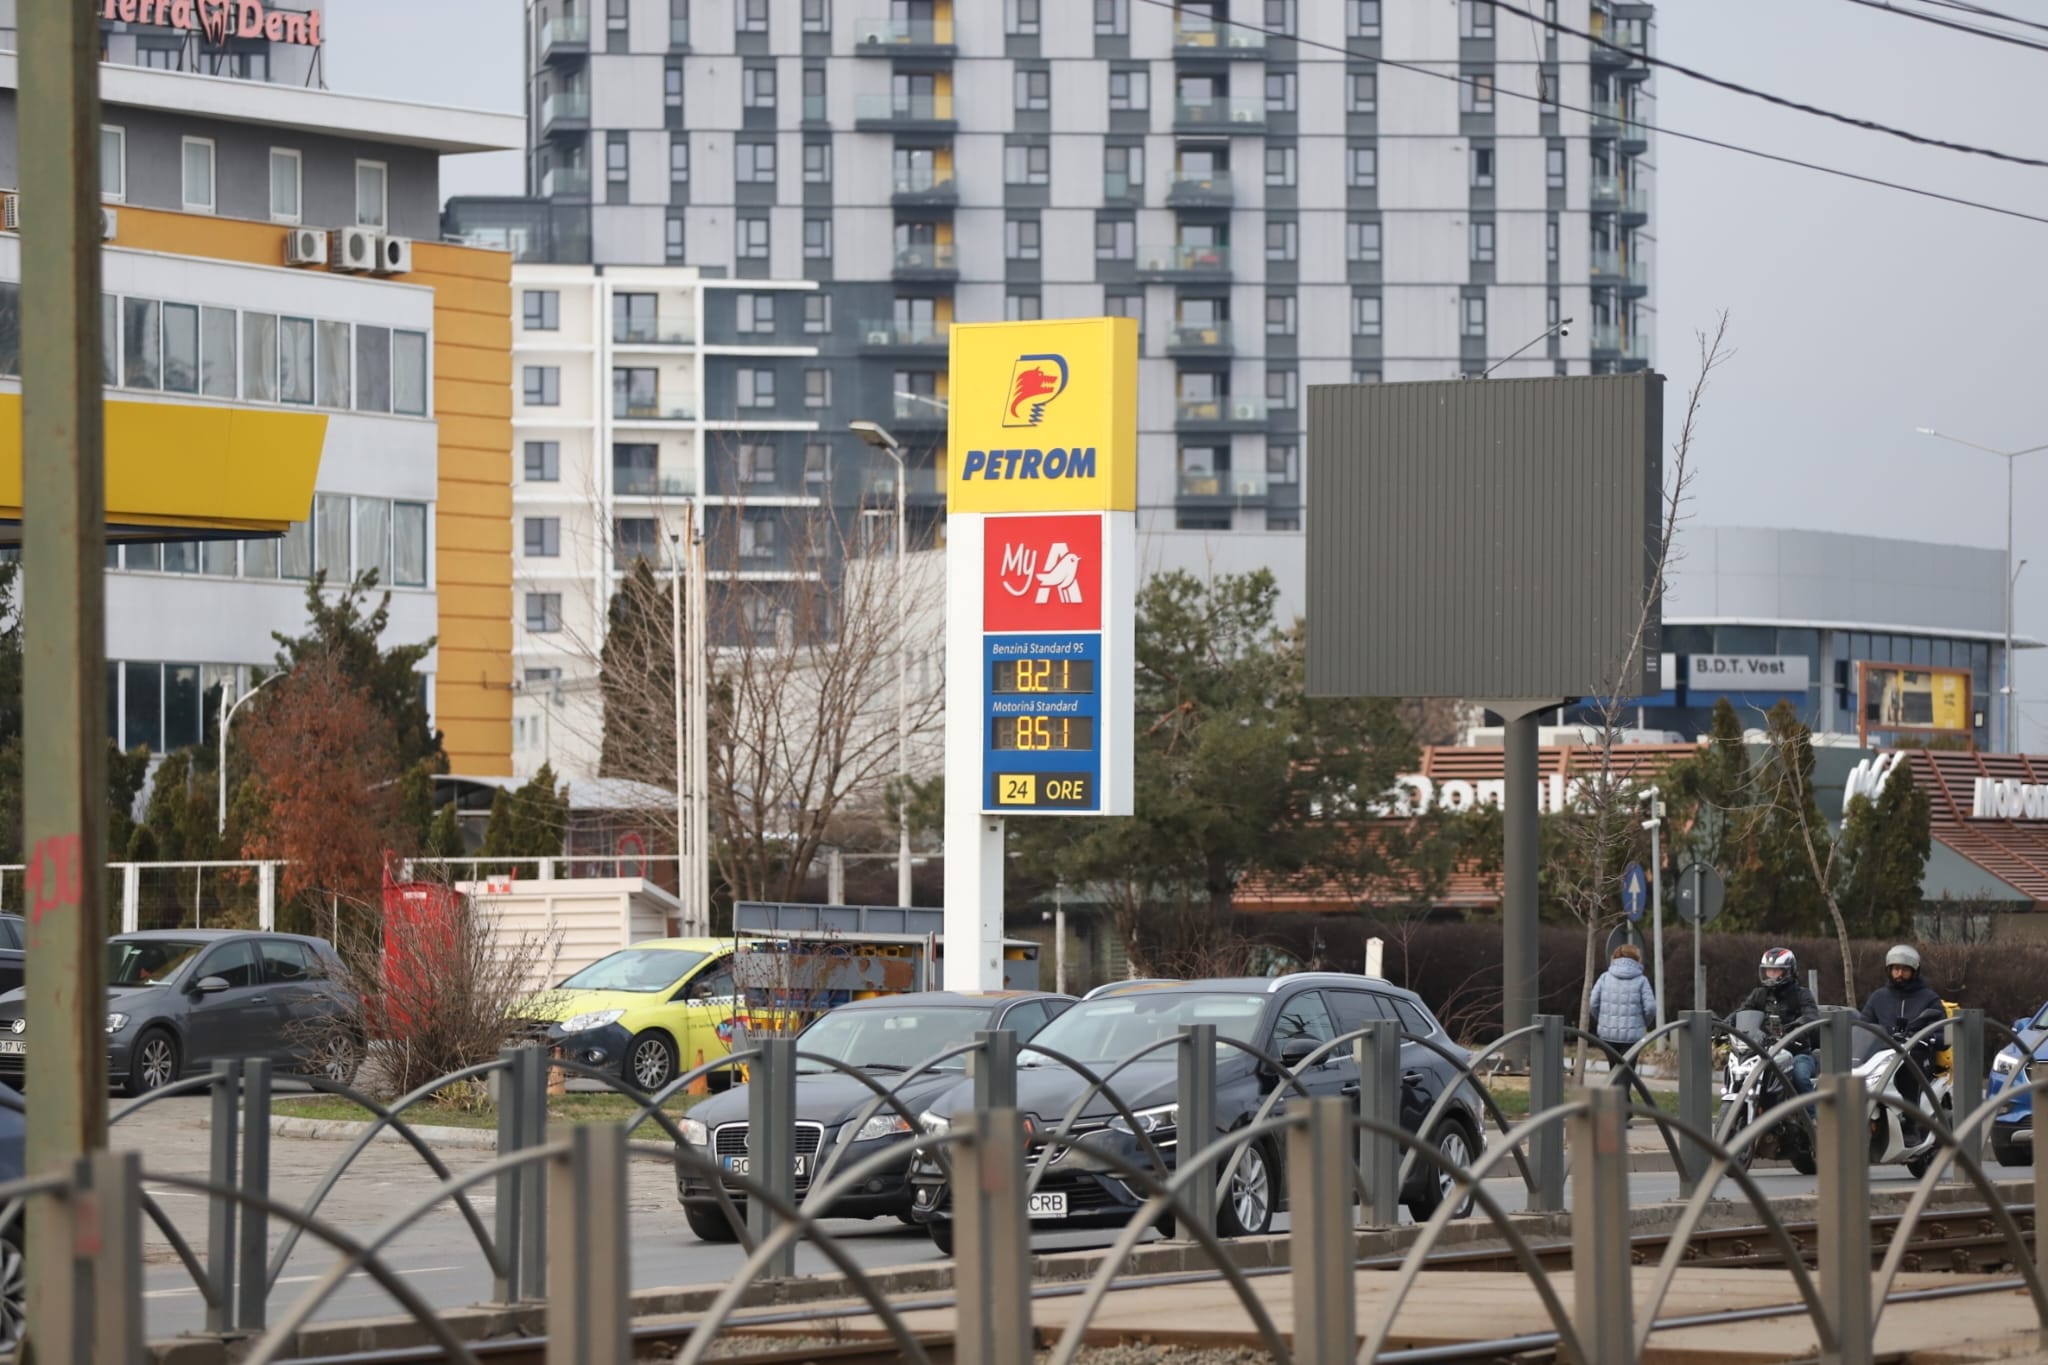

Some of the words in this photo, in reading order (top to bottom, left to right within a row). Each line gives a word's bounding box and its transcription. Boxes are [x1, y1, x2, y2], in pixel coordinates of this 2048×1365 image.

[237, 0, 320, 47] Dent
[962, 447, 1096, 481] PETROM
[1000, 542, 1037, 597] My
[1030, 642, 1072, 654] Standard
[1073, 642, 1084, 654] 95
[1017, 659, 1069, 692] 8.21
[1696, 659, 1743, 674] B.D.T.
[1748, 659, 1785, 674] Vest
[1036, 700, 1078, 712] Standard
[1017, 715, 1069, 750] 8.51
[1007, 780, 1028, 799] 24
[1046, 780, 1084, 800] ORE
[1029, 1194, 1063, 1212] CRB
